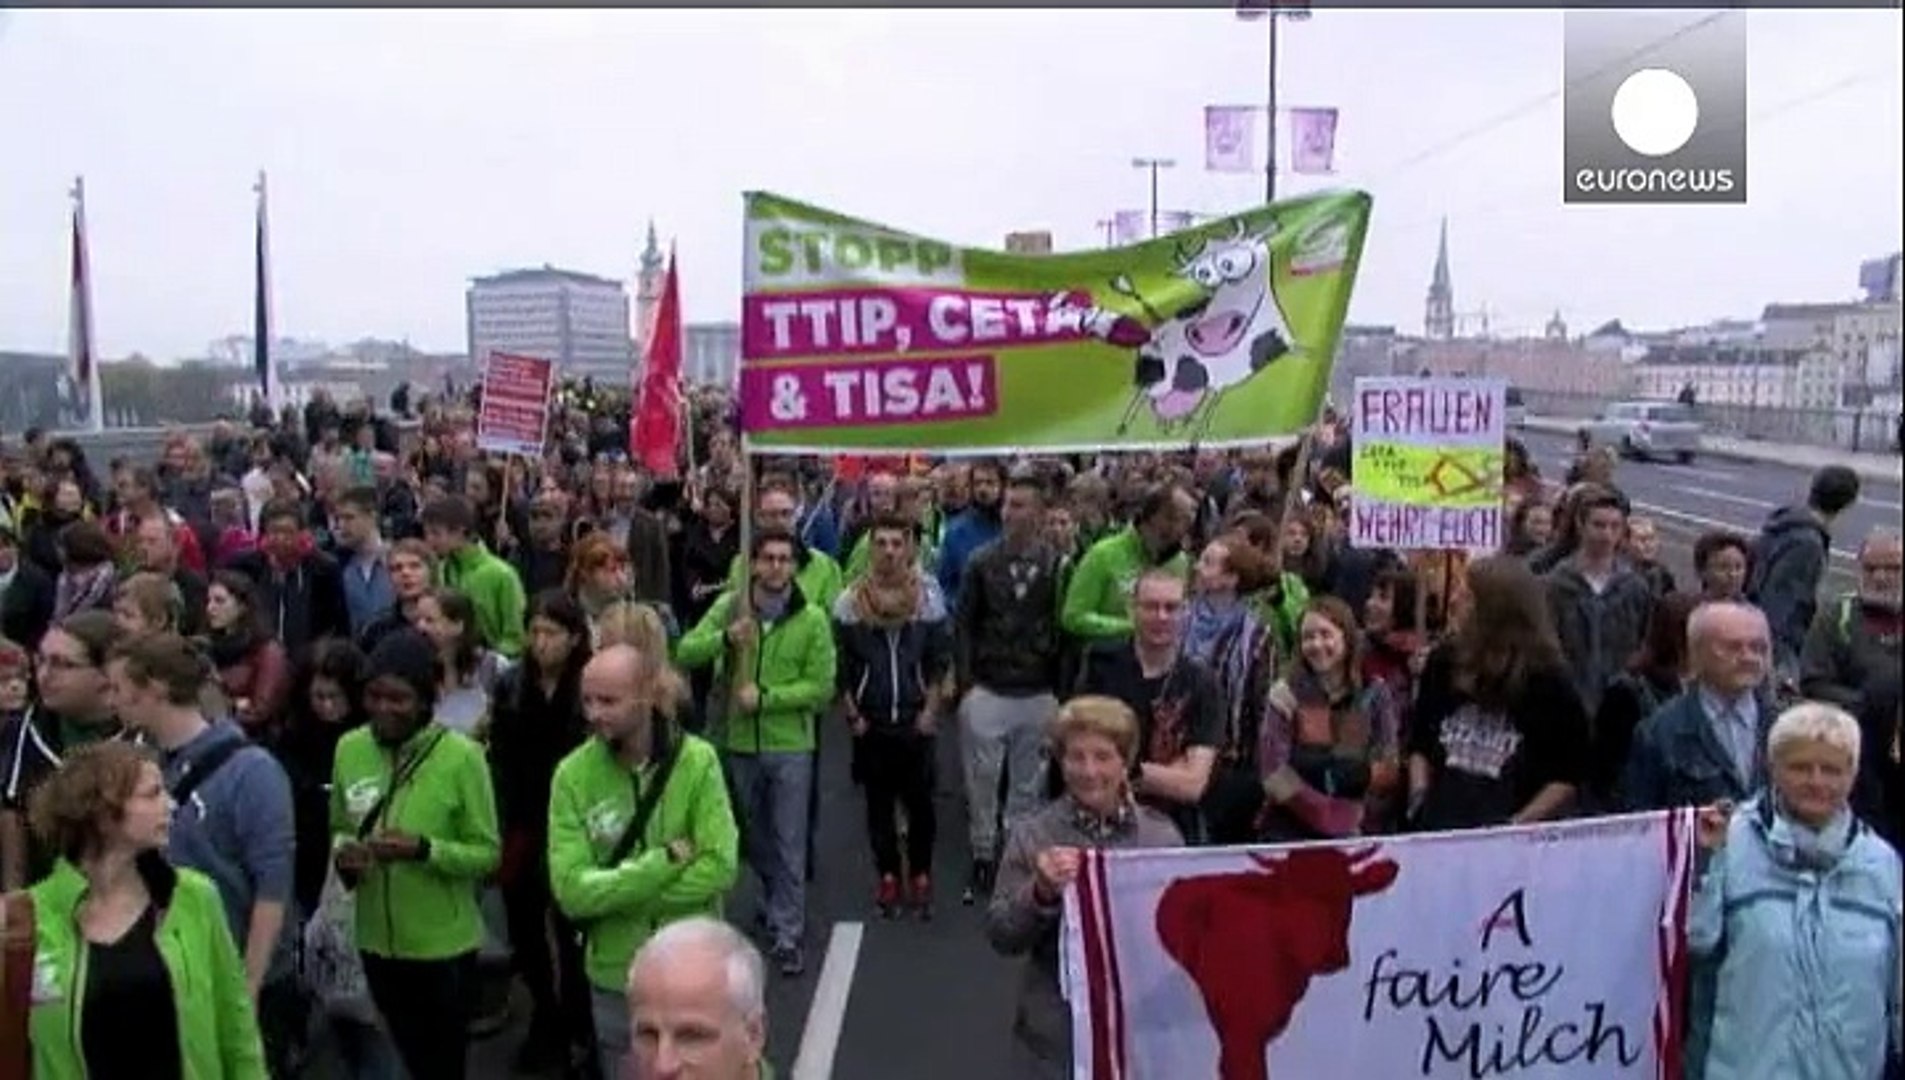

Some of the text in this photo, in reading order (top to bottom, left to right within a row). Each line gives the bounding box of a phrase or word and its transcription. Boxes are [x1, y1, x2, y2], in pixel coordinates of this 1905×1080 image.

[759, 228, 952, 275] STOPP
[763, 297, 912, 353] TTIP,
[770, 364, 984, 419] & TISA!
[1361, 388, 1492, 434] FRAUEN
[1356, 506, 1498, 547] WEHRT EUCH
[1480, 887, 1532, 950] A
[1364, 949, 1563, 1021] faire
[1423, 1001, 1642, 1079] Milch
